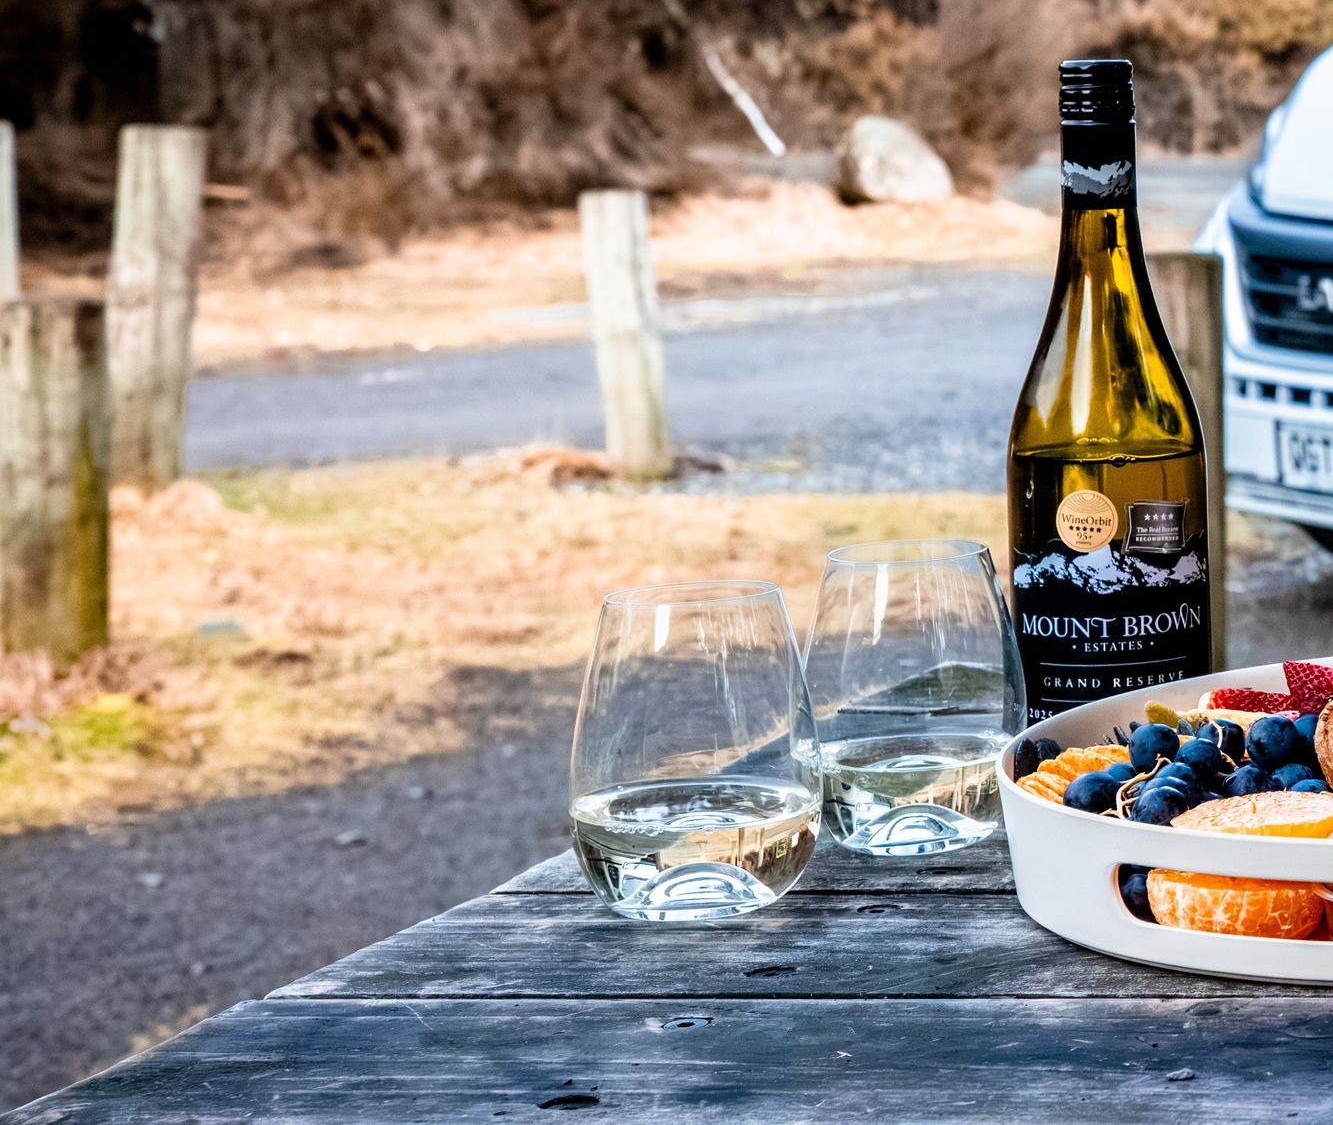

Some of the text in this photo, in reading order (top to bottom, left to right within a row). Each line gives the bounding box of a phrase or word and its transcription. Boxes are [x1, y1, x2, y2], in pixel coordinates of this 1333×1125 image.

[1062, 513, 1112, 527] WineOrbit
[1022, 603, 1201, 639] MOUNT BROWN
[1084, 640, 1143, 653] ESTATES
[1043, 670, 1184, 689] GRAND RESERVE
